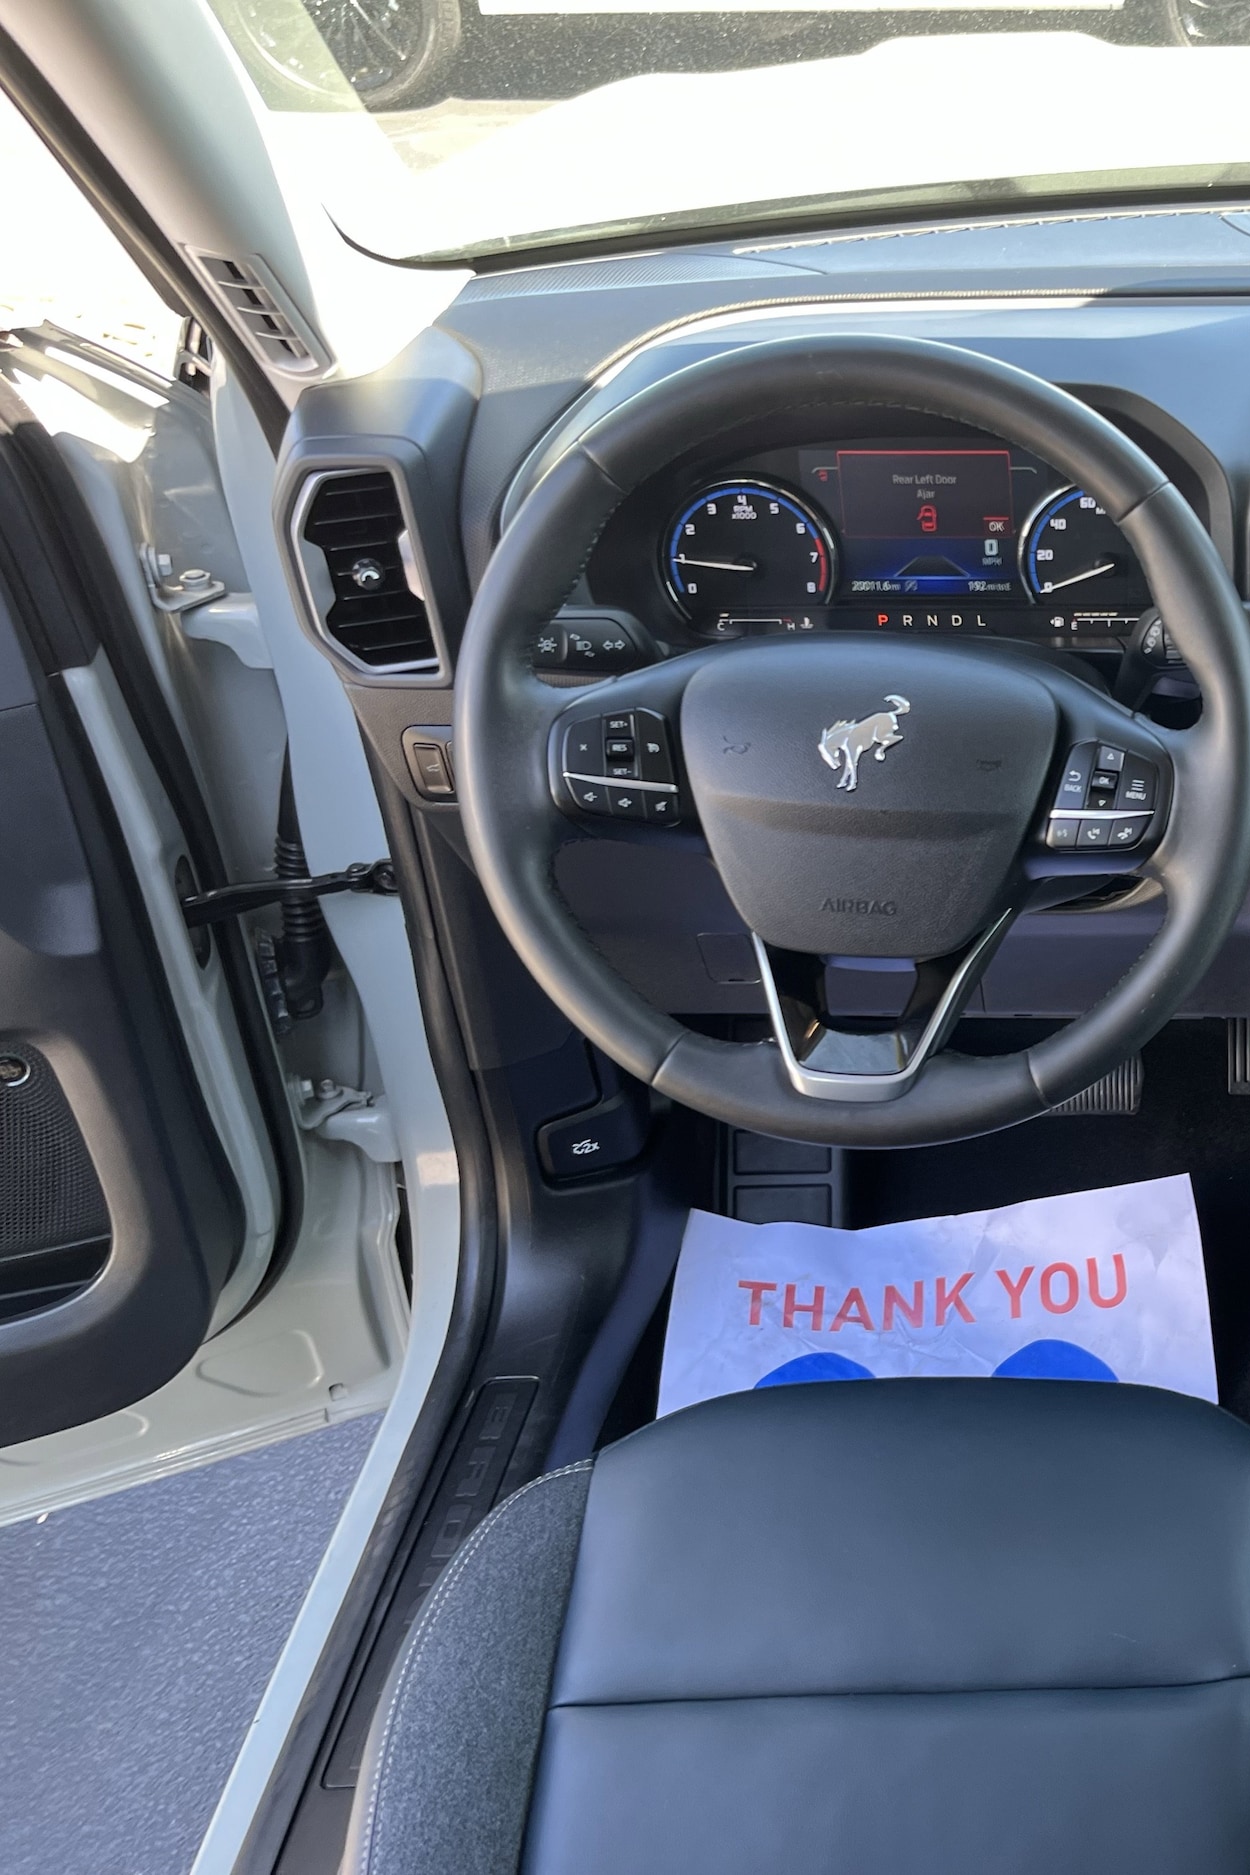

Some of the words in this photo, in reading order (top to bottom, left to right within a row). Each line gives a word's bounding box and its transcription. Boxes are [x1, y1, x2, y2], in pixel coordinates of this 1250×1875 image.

[892, 474, 914, 485] Rear
[915, 474, 934, 485] Left
[935, 474, 957, 485] Door
[916, 488, 936, 500] Ajar
[737, 495, 747, 506] 4
[1080, 497, 1096, 509] 60
[707, 503, 717, 515] 3
[733, 505, 753, 513] RPM
[769, 503, 780, 514] 5
[796, 523, 806, 534] 6
[988, 520, 1005, 532] OK
[1050, 518, 1067, 530] 40
[685, 524, 696, 536] 2
[983, 539, 999, 556] 0
[809, 552, 818, 563] 7
[1036, 549, 1053, 560] 20
[688, 583, 697, 594] 0
[806, 582, 816, 593] 8
[877, 614, 889, 626] P
[902, 614, 913, 626] R
[927, 614, 938, 626] N
[951, 615, 962, 626] D
[977, 615, 986, 626] L
[717, 623, 725, 631] C
[1071, 621, 1078, 631] E
[1098, 777, 1110, 785] OK
[1064, 784, 1082, 793] BACK
[1125, 791, 1147, 801] MENU
[820, 897, 898, 917] AIRBAG
[737, 1272, 978, 1333] THANK
[995, 1253, 1129, 1319] YOU
